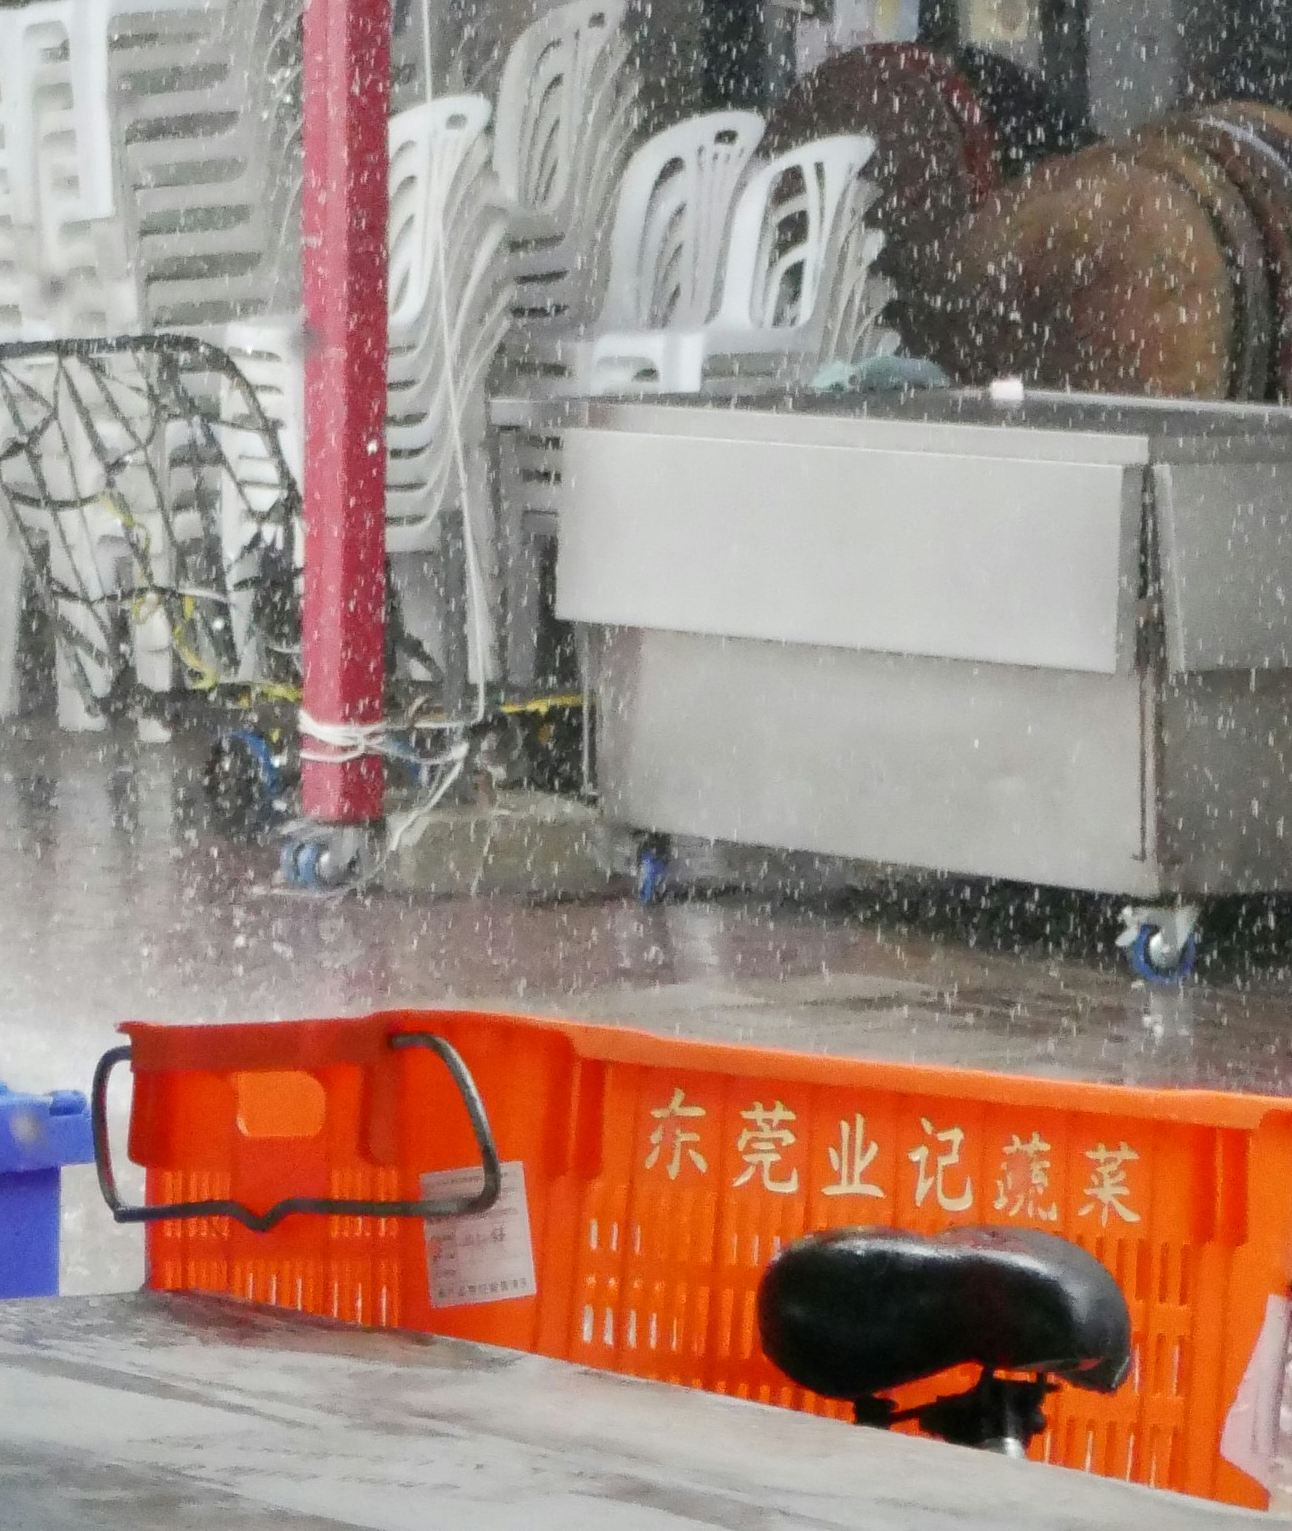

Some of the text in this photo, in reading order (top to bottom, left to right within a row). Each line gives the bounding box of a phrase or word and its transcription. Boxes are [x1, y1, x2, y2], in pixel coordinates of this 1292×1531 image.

[645, 1089, 1141, 1225] 东莞业记蔬菜
